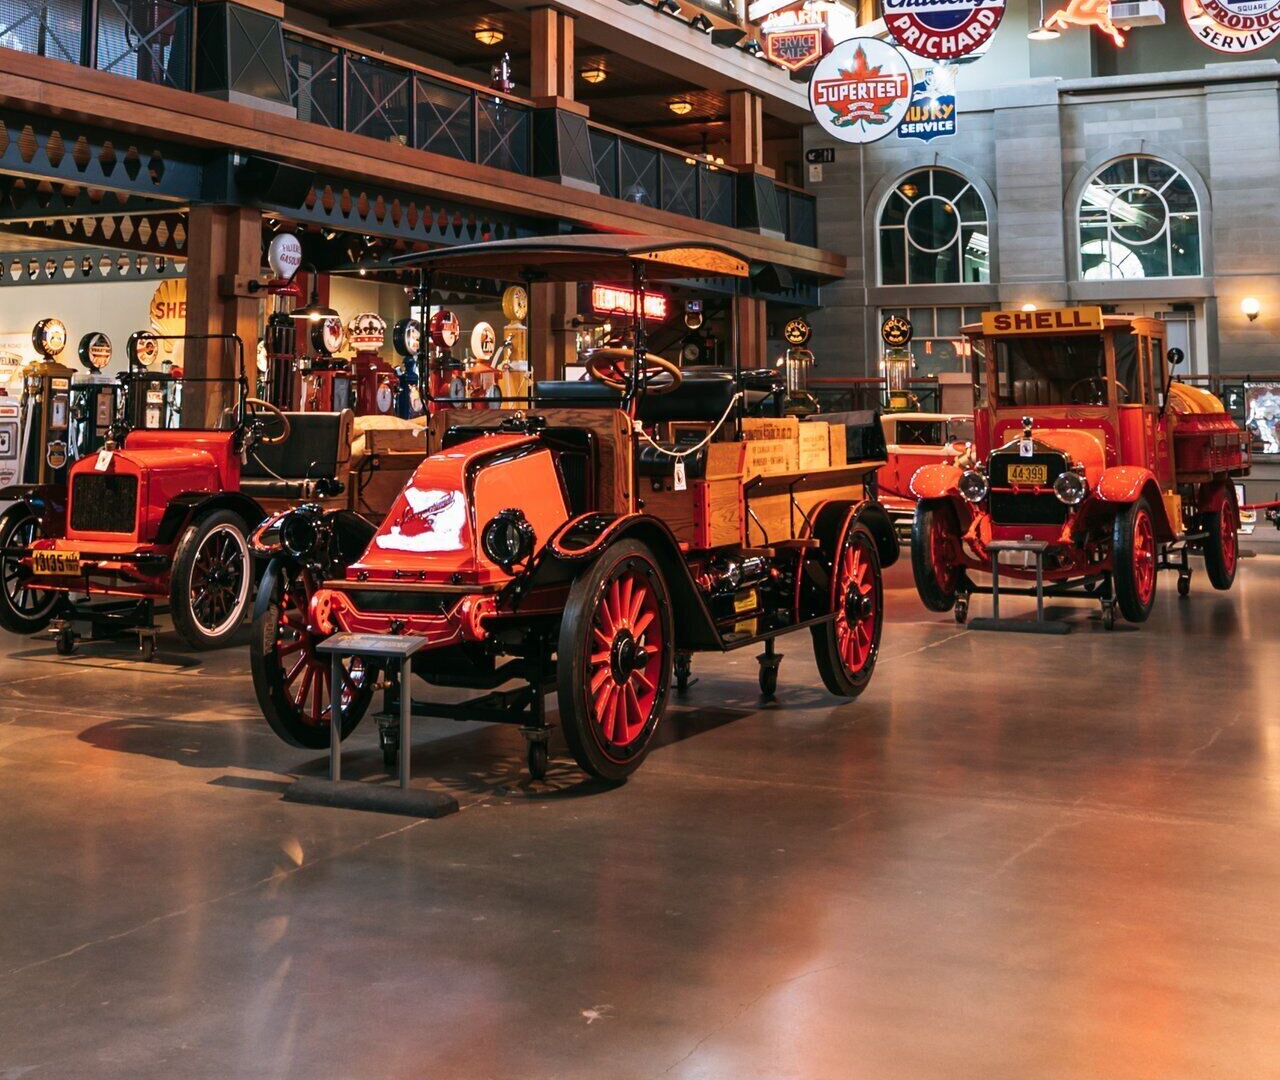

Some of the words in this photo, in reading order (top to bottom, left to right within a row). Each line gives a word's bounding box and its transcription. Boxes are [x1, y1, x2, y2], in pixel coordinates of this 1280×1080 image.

[1237, 2, 1267, 13] SQUARE
[892, 7, 995, 54] PRICHARD
[1199, 25, 1280, 49] SERVICE
[772, 35, 815, 49] SERVICE
[780, 47, 810, 60] SALES
[818, 75, 906, 103] SUPERTEST
[900, 120, 953, 134] SERVICE
[993, 310, 1092, 332] SHELL
